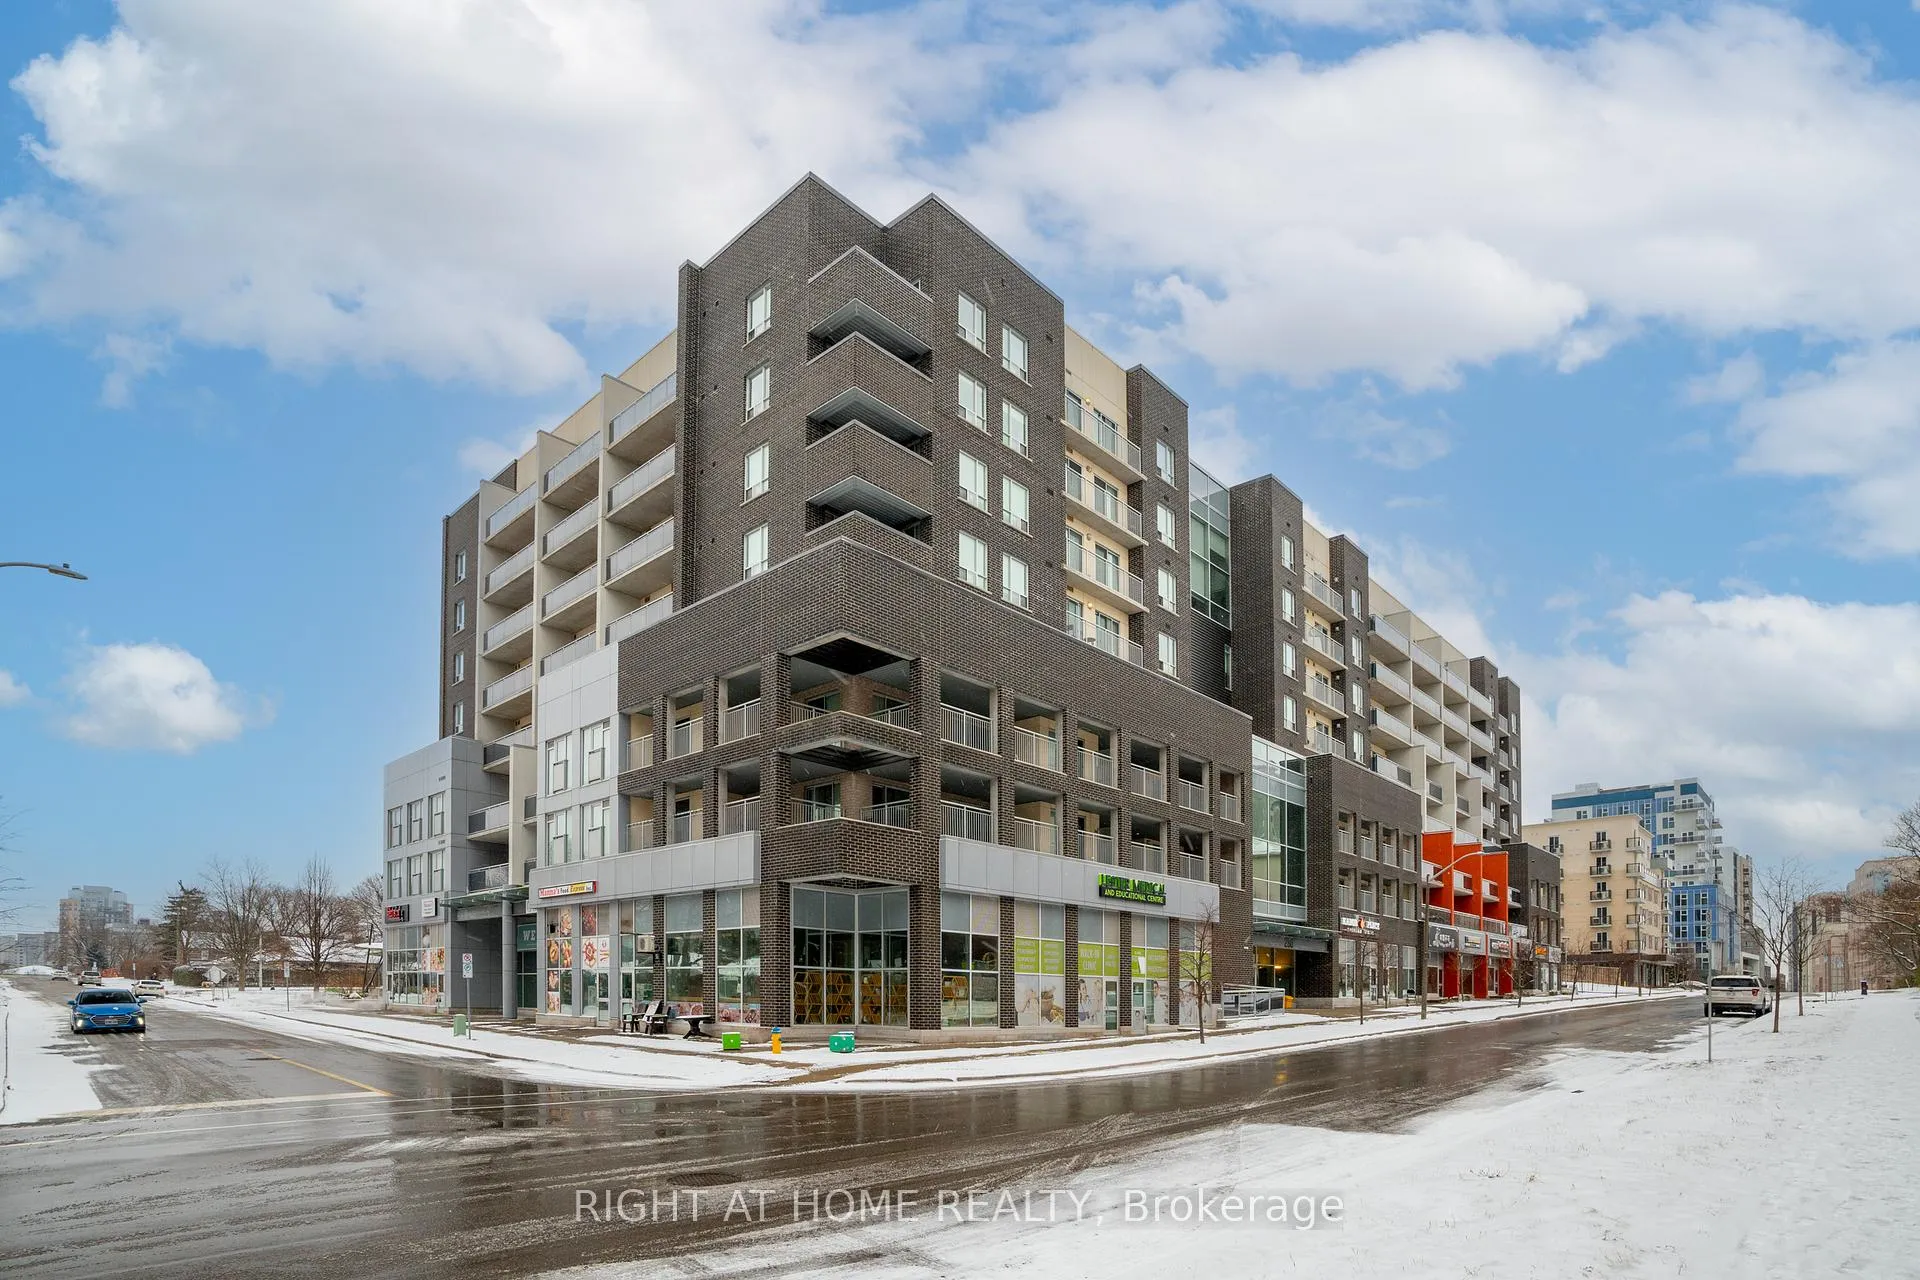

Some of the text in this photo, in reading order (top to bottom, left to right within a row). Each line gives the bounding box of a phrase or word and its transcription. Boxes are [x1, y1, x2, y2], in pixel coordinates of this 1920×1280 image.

[1105, 888, 1164, 904] AND EDUCATIONAL CENTRE
